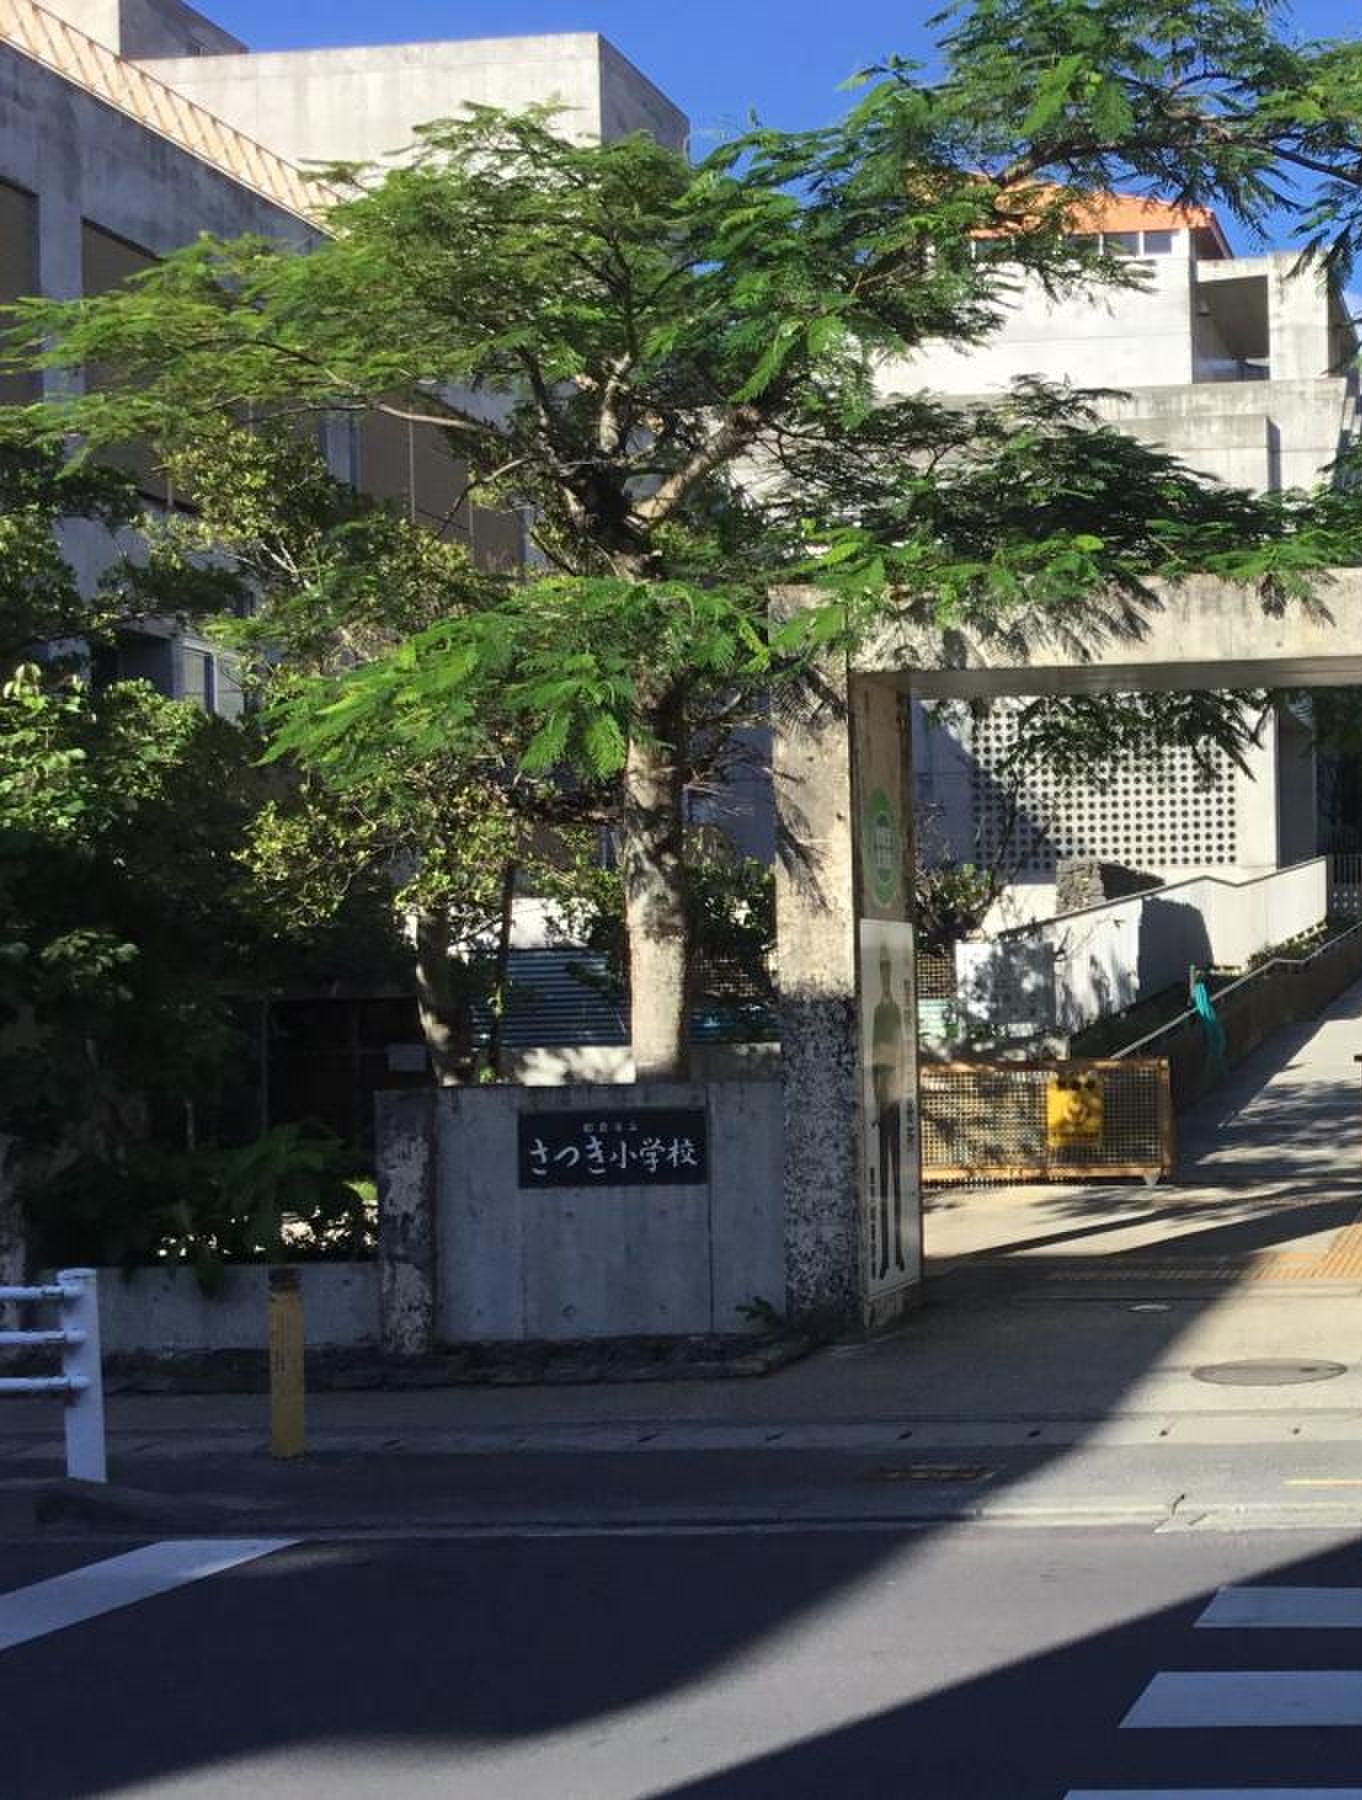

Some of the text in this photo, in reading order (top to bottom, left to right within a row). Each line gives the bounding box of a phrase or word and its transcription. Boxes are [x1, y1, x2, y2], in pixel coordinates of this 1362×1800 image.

[529, 1136, 698, 1175] さつき小学校
